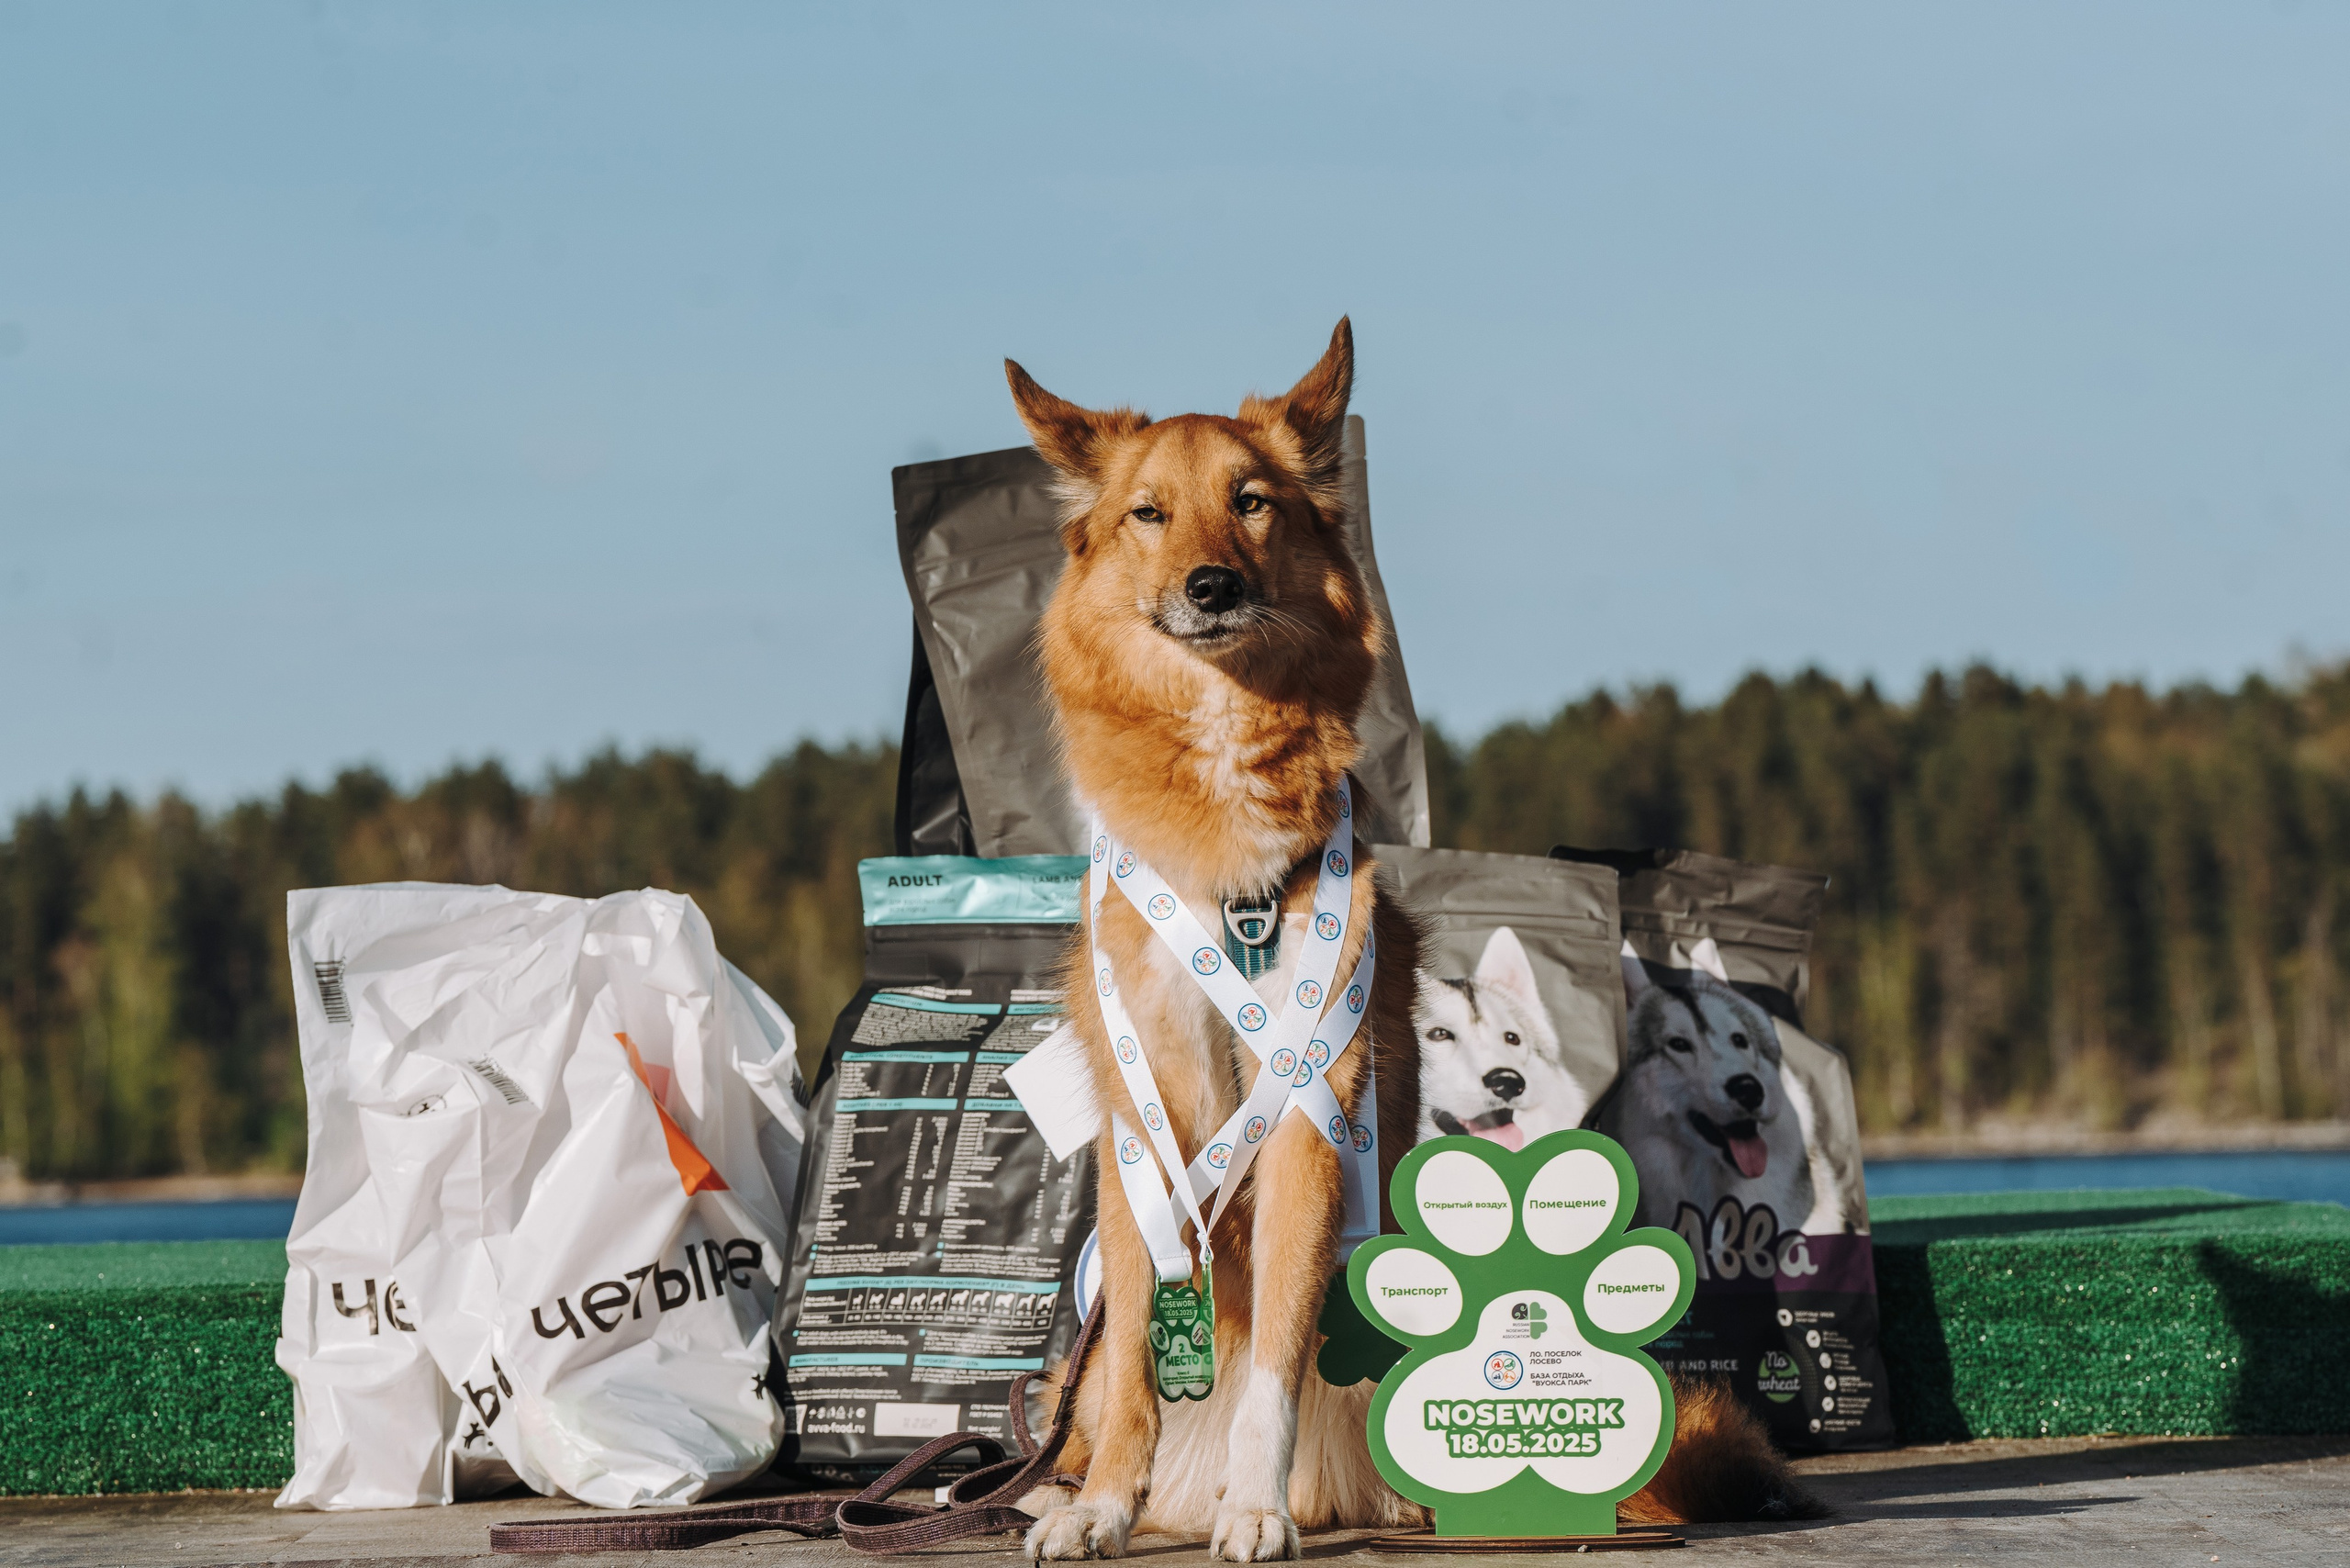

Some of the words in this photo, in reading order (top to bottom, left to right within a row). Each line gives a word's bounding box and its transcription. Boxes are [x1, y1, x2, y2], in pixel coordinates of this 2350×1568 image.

[888, 875, 943, 887] ADULT
[1423, 1200, 1473, 1211] Открытый
[1475, 1201, 1507, 1211] воздух
[1529, 1198, 1607, 1210] Помещение
[531, 1238, 763, 1339] четыре
[1380, 1286, 1449, 1299] Транспорт
[1597, 1282, 1665, 1295] Предметы
[1159, 1299, 1196, 1309] NOSEWORK
[1164, 1309, 1193, 1317] 18.05.2025
[1179, 1342, 1185, 1353] 2
[1165, 1354, 1200, 1367] МЕСТО
[1764, 1350, 1788, 1368] No
[1709, 1360, 1740, 1372] RICE
[1551, 1372, 1585, 1380] ОТДЫХА
[1757, 1374, 1802, 1392] wheat
[1427, 1402, 1621, 1427] NOSEWORK
[807, 1421, 866, 1434] avva-food.ru
[1449, 1432, 1597, 1454] 18.05.2025
